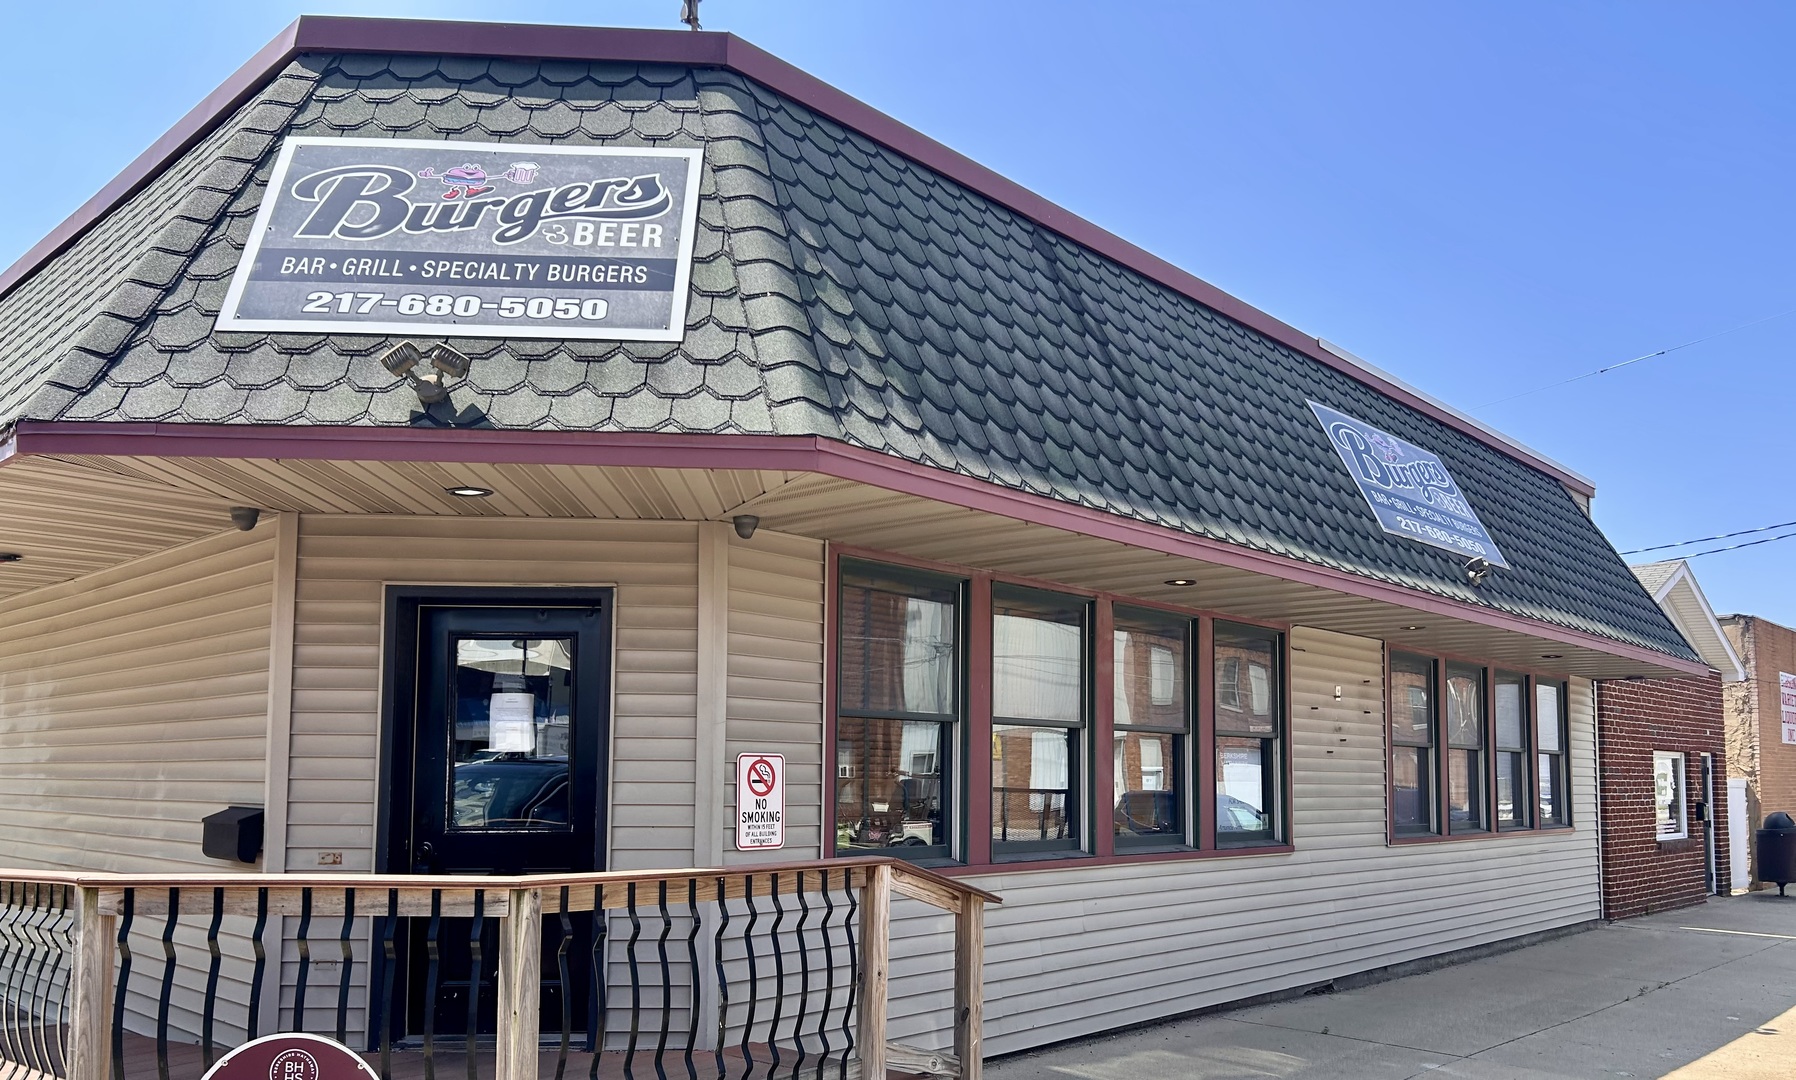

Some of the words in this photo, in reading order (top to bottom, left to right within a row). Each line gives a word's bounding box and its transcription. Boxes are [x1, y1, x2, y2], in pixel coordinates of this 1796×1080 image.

[291, 164, 673, 246] Burgers
[572, 223, 663, 247] BEER
[280, 256, 324, 275] BAR
[342, 259, 403, 278] GRILL
[421, 260, 541, 281] SPECIALTY
[547, 264, 648, 284] BURGERS
[302, 291, 609, 320] 217-680-5050
[1330, 421, 1458, 504] Burgers
[1371, 490, 1391, 506] BAR
[1391, 497, 1416, 514] GRILL
[1415, 505, 1453, 527] SPECIALTY
[1396, 515, 1486, 555] 217-680-5050
[741, 811, 780, 824] SMOKING
[755, 798, 767, 810] NO
[285, 1061, 304, 1073] BH
